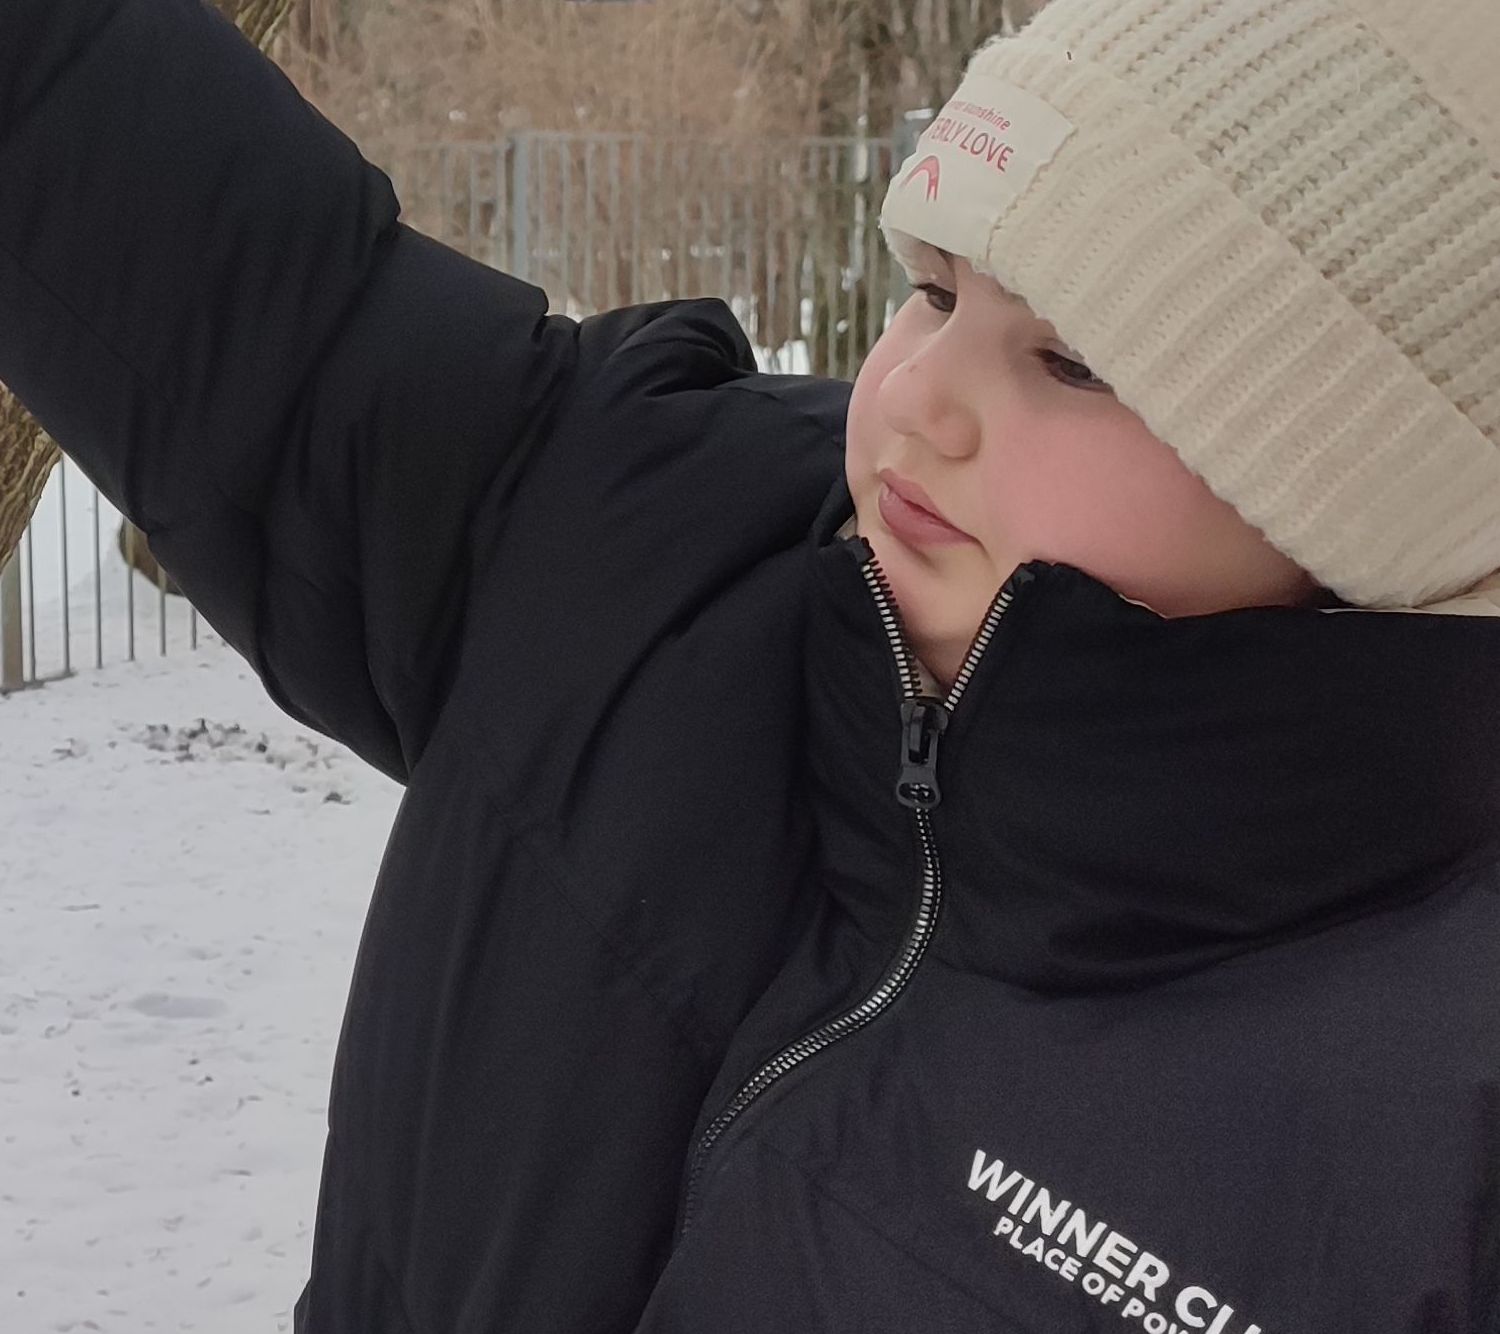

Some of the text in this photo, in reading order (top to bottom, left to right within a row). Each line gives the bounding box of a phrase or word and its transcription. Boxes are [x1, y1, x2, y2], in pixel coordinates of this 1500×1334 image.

[929, 117, 1014, 172] ERLY LOVE
[967, 1149, 1170, 1302] WINNER
[994, 1216, 1083, 1282] PLACE
[1082, 1271, 1126, 1305] OF
